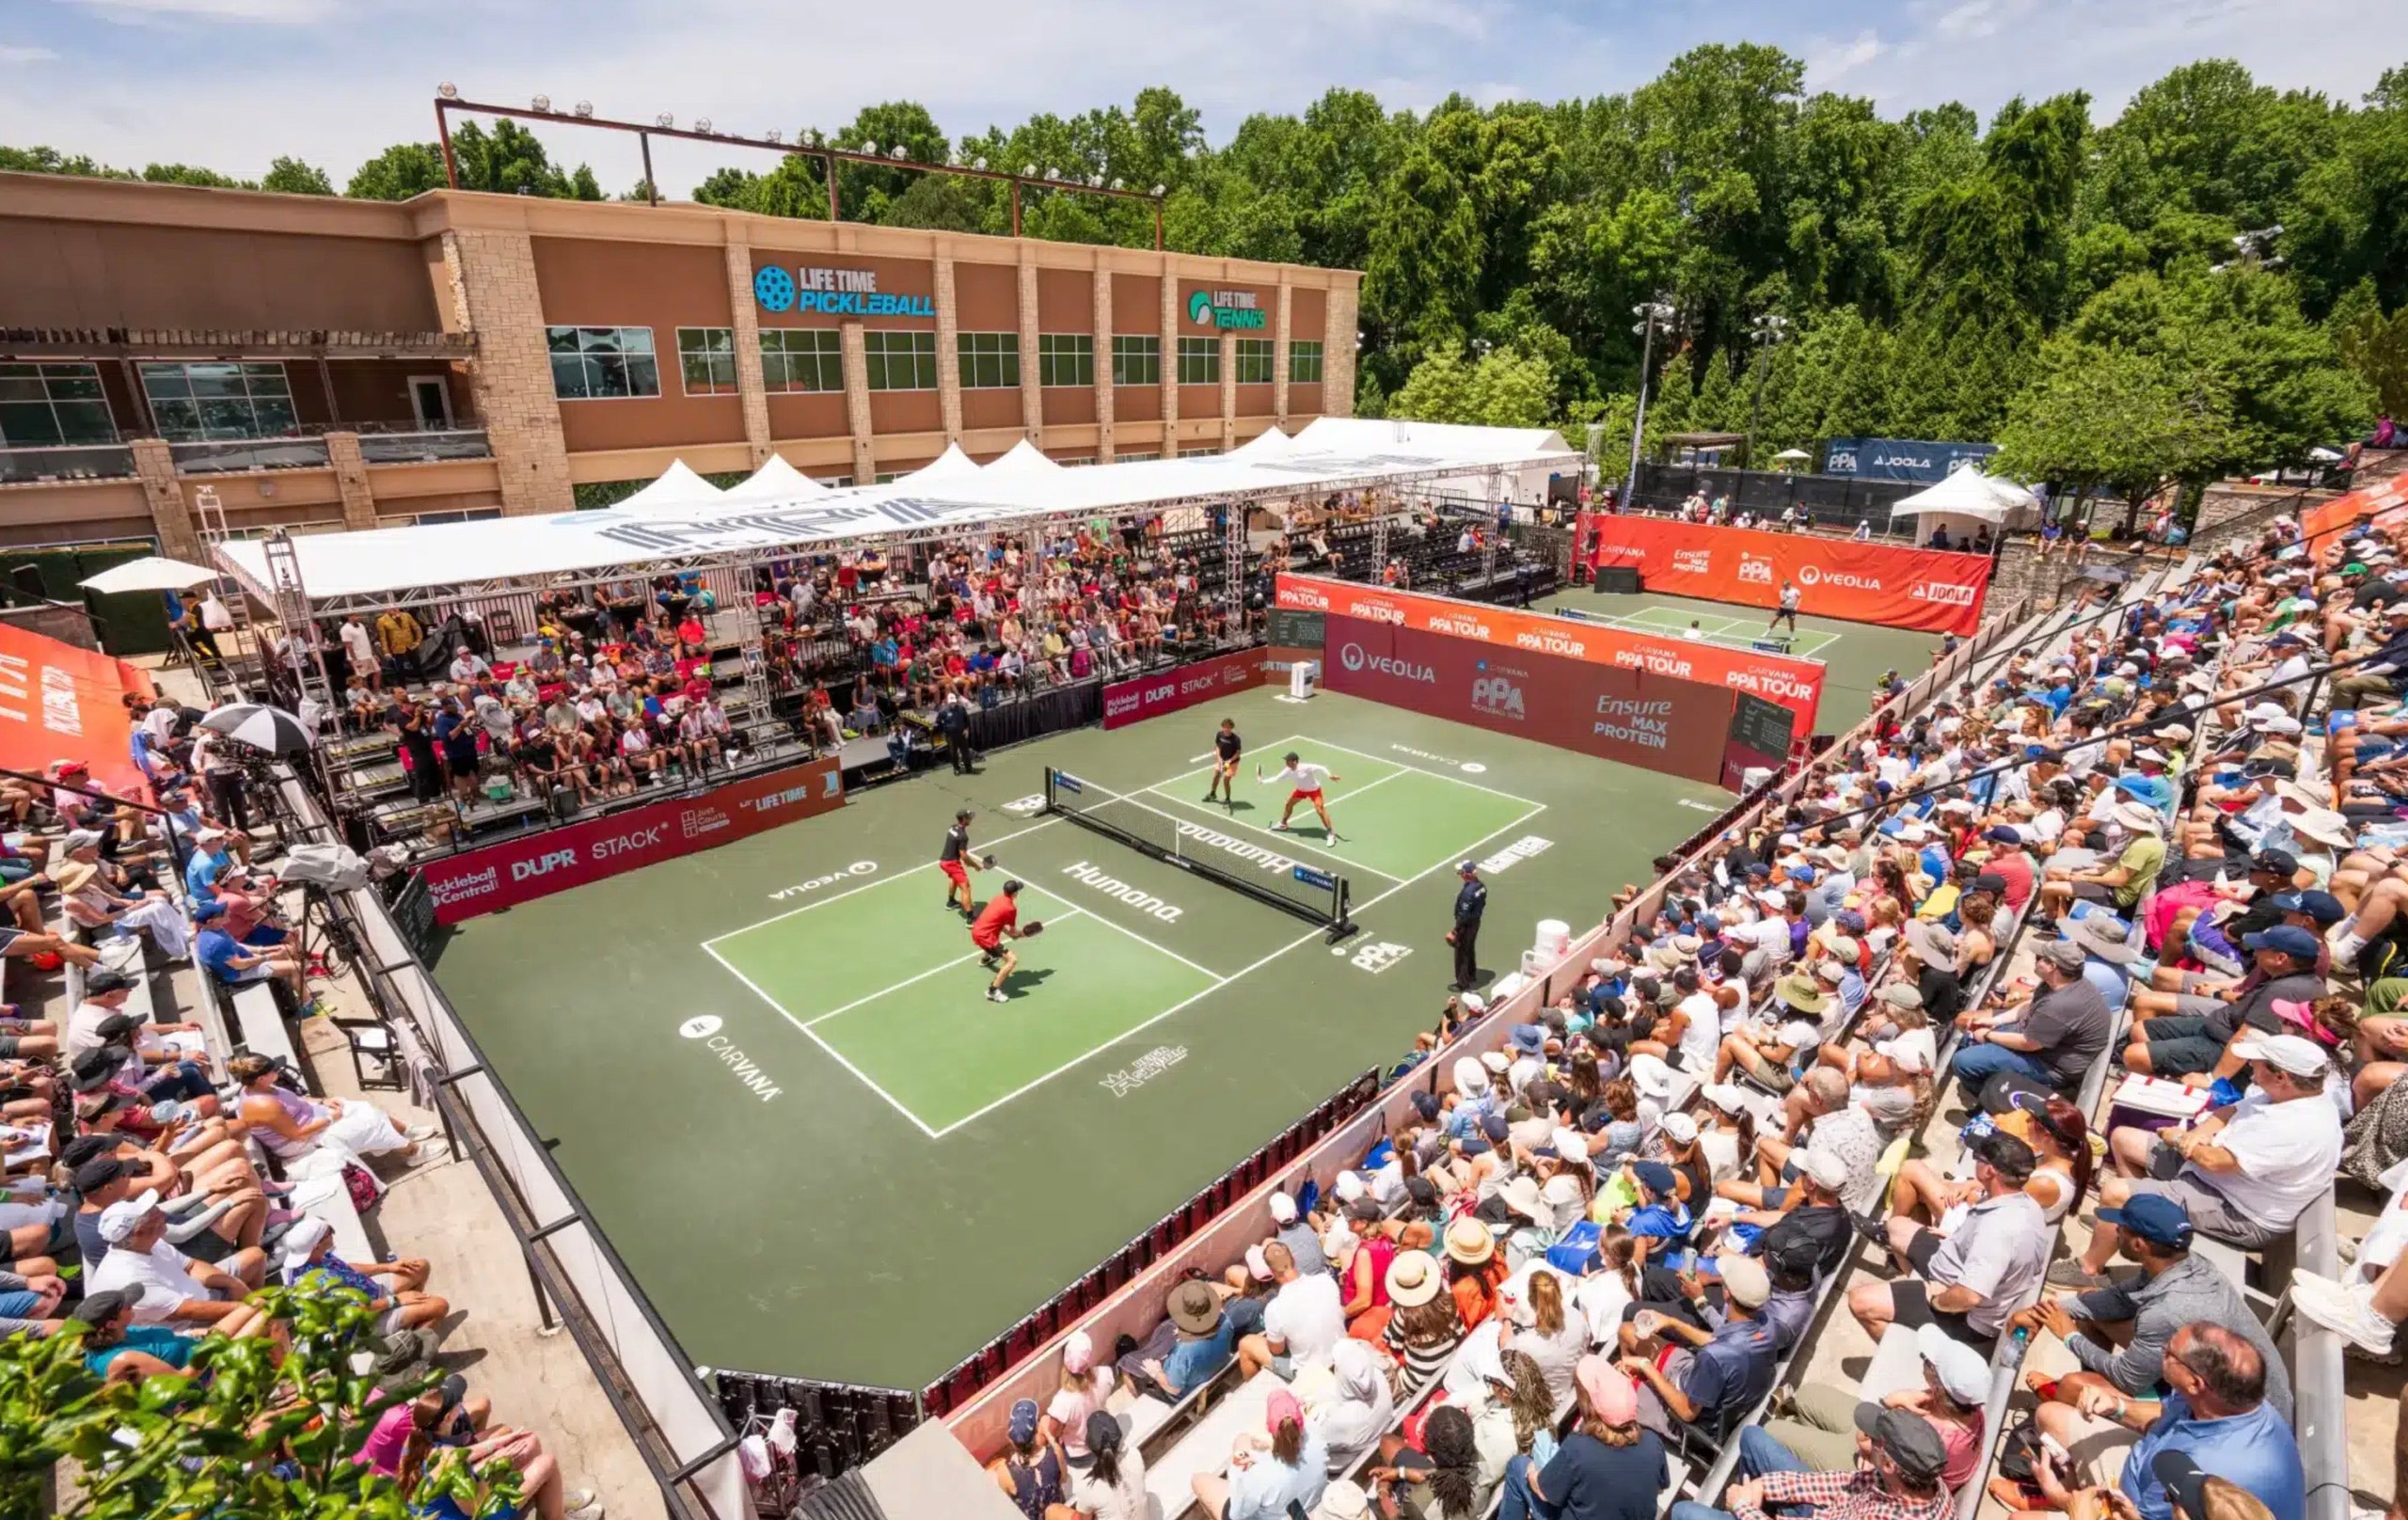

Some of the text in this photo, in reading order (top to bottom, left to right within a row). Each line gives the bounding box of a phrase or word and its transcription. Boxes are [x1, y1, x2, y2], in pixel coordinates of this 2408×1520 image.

[800, 267, 877, 293] LIFE TIME
[800, 292, 935, 316] PICKLEBALL
[1213, 290, 1256, 309] LIFE TIME
[1829, 452, 1857, 469] PPA
[1884, 457, 1930, 468] JOOLA
[1599, 545, 1645, 558] CARVANA
[1738, 561, 1772, 580] PPA
[1822, 572, 1881, 591] VEOLIA
[1279, 590, 1329, 610] PPA TOUR
[1931, 585, 1972, 602] JOOLA
[1351, 602, 1405, 624] PPA TOUR
[1429, 616, 1490, 640] PPA TOUR
[1516, 632, 1585, 657] PPA TOUR
[1633, 644, 1677, 659] CARVANA
[1367, 654, 1435, 684] VEOLIA
[1615, 650, 1692, 677] PPA TOUR
[1748, 665, 1796, 681] CARVANA
[1146, 685, 1175, 704] DUPR
[1181, 676, 1213, 694] STACK
[1471, 676, 1525, 714] PPA
[1726, 671, 1814, 701] PPA TOUR
[1597, 694, 1671, 715] Ensure
[1594, 721, 1667, 749] PROTEIN
[1631, 715, 1669, 735] MAX
[755, 794, 780, 812] LIFE
[781, 785, 808, 805] TIME
[592, 826, 661, 859] STACK
[512, 848, 578, 881] DUPR
[768, 872, 850, 900] VEOLIA
[1061, 861, 1184, 923] Humana.
[707, 1036, 782, 1101] CARVANA
